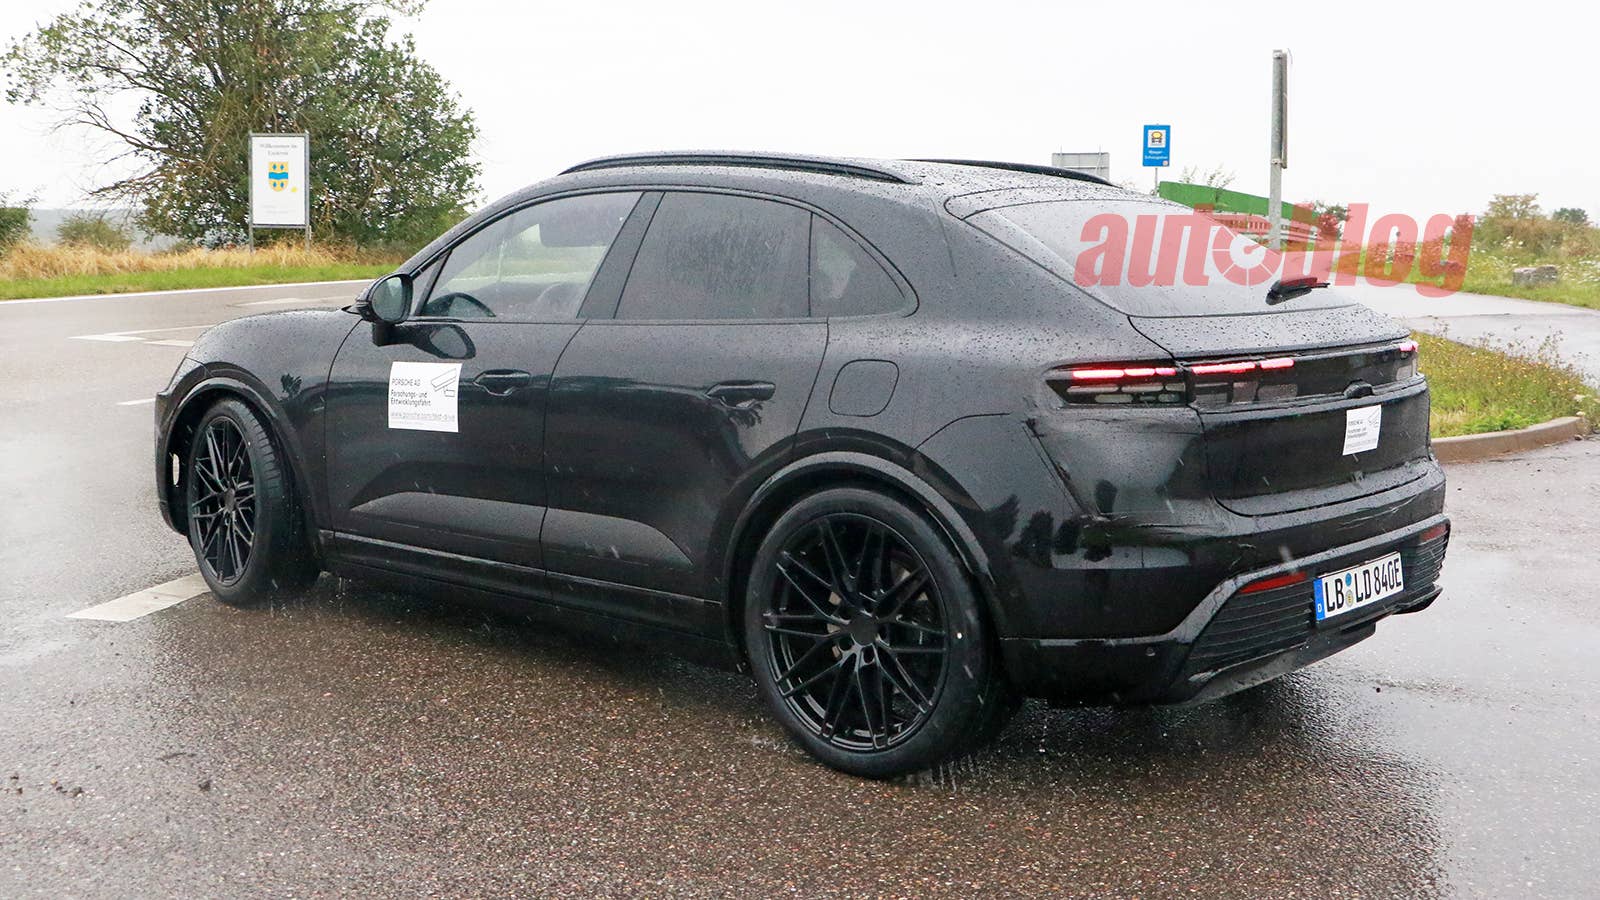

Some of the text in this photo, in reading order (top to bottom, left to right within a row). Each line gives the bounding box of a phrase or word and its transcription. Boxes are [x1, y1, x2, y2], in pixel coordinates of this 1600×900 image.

[392, 378, 414, 387] PORSCHE
[391, 389, 419, 399] Forschungs-
[1325, 578, 1345, 612] LB
[1354, 569, 1372, 602] LD
[1373, 558, 1402, 595] 840E
